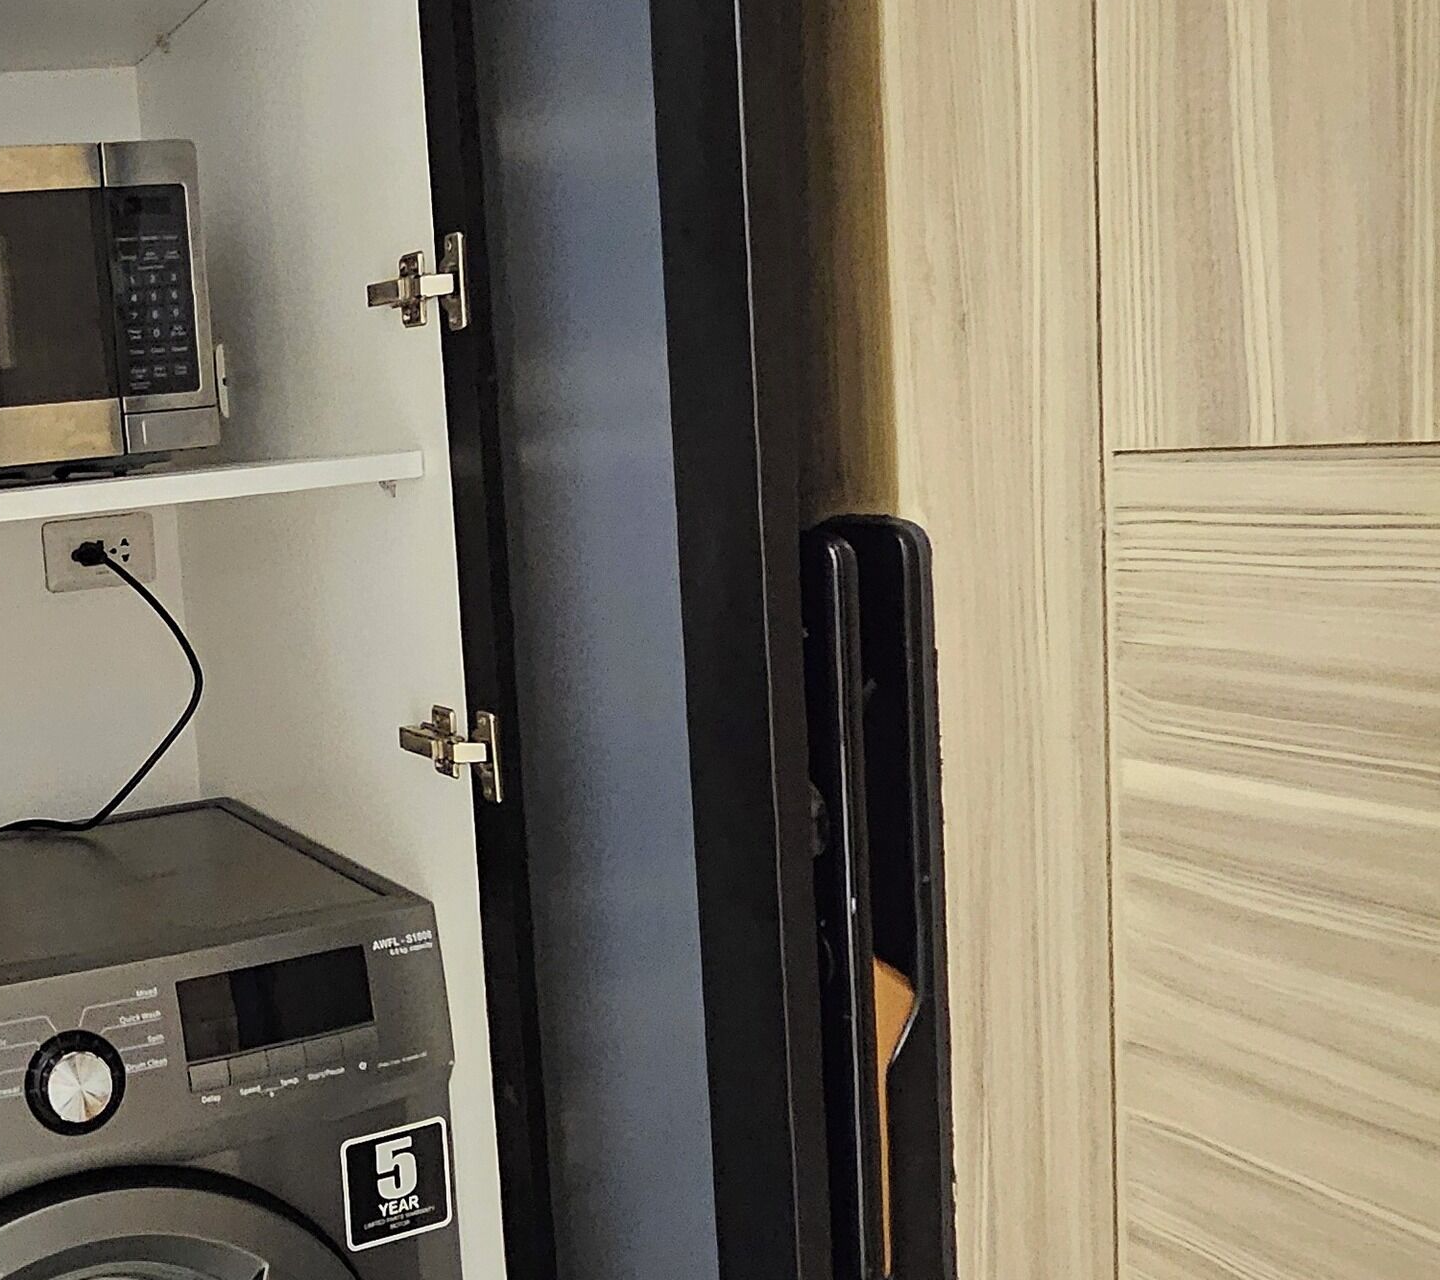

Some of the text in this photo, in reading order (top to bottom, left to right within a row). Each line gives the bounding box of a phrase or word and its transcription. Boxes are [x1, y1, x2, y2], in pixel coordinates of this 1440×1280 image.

[372, 937, 400, 951] AWFL
[375, 1136, 417, 1200] 5
[378, 1194, 419, 1217] YEAR
